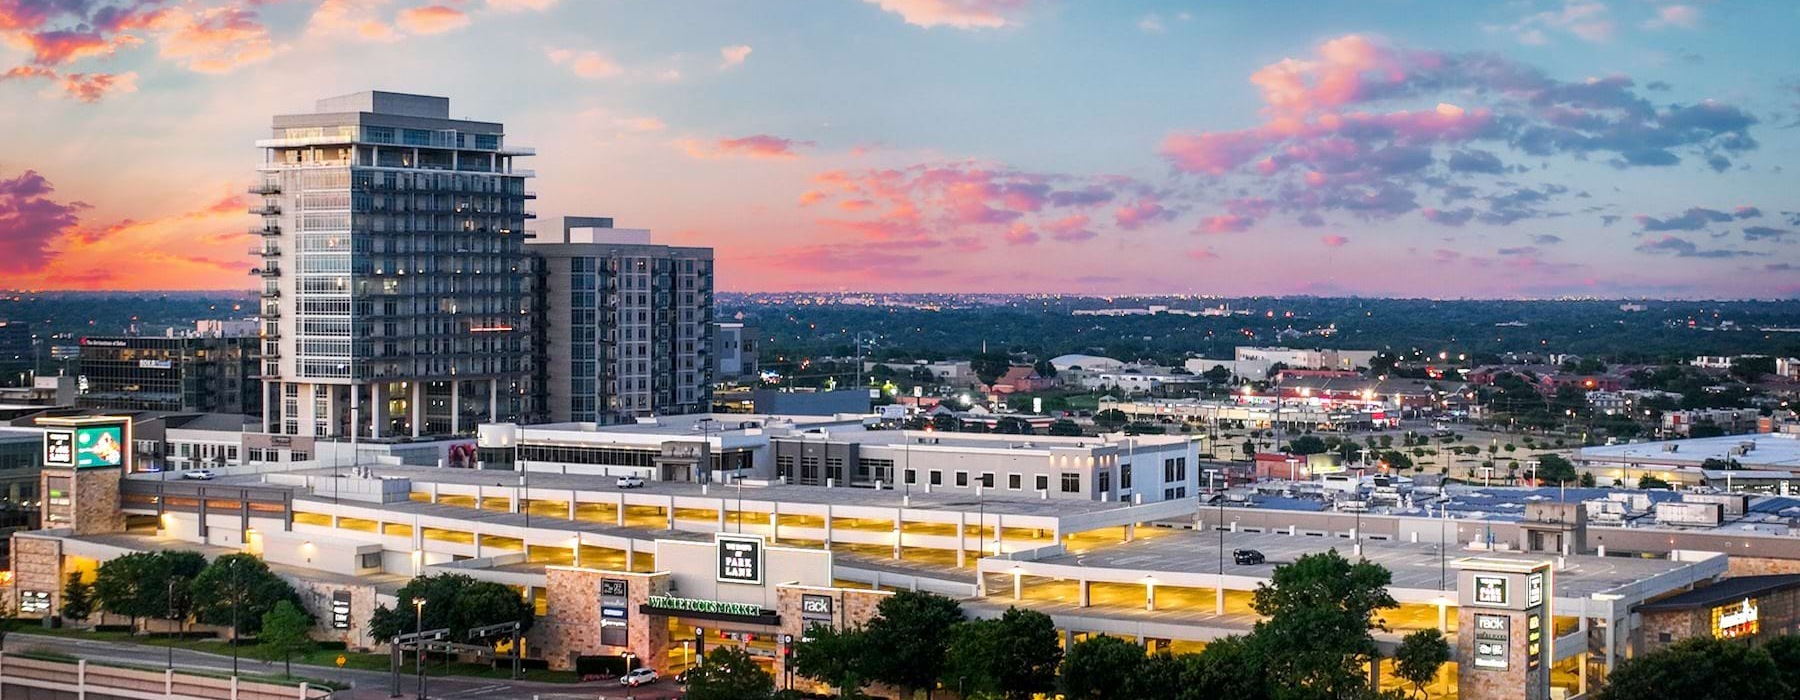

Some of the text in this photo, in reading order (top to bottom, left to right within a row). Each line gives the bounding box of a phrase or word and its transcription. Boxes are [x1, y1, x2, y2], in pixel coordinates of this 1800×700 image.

[725, 556, 752, 568] PARK
[725, 566, 752, 578] LANE
[648, 593, 762, 617] WHOLE FOODS MARKET
[804, 598, 828, 613] rack
[1479, 616, 1504, 630] rack
